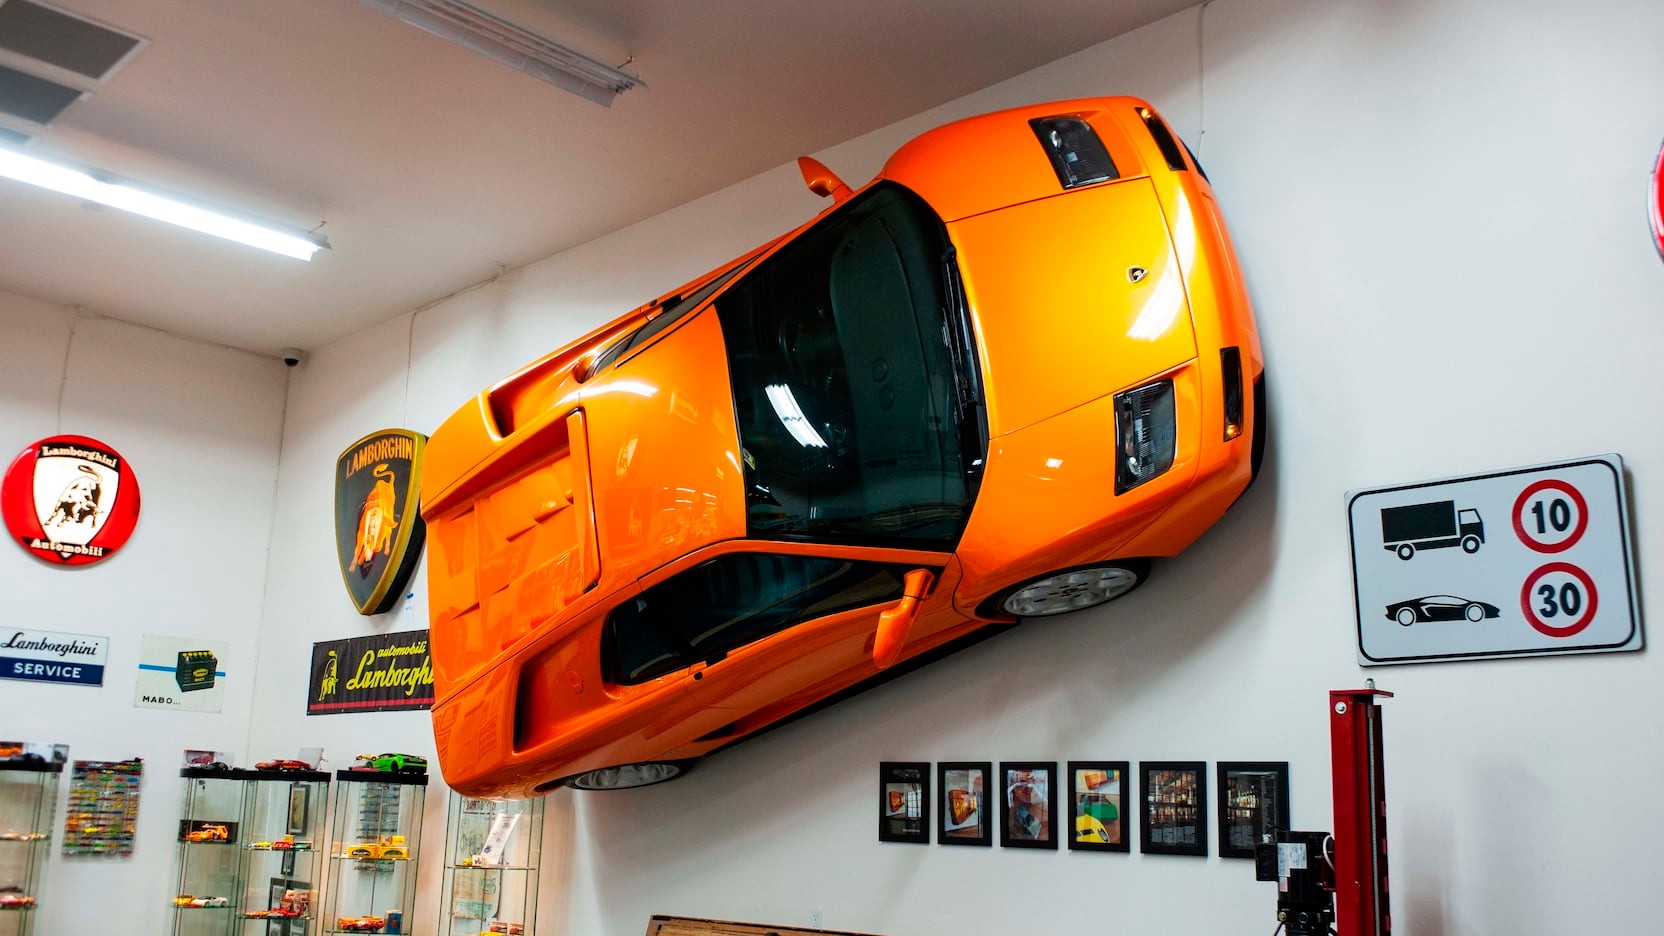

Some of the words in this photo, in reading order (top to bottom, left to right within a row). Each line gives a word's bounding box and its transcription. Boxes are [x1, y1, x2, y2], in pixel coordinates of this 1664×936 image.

[42, 446, 117, 468] Lamborghini
[1531, 498, 1571, 534] 10
[30, 538, 103, 557] Automobili
[1537, 582, 1581, 618] 30
[1, 632, 99, 657] Lamborghini
[377, 641, 428, 658] automobili
[14, 662, 82, 679] SERVICE
